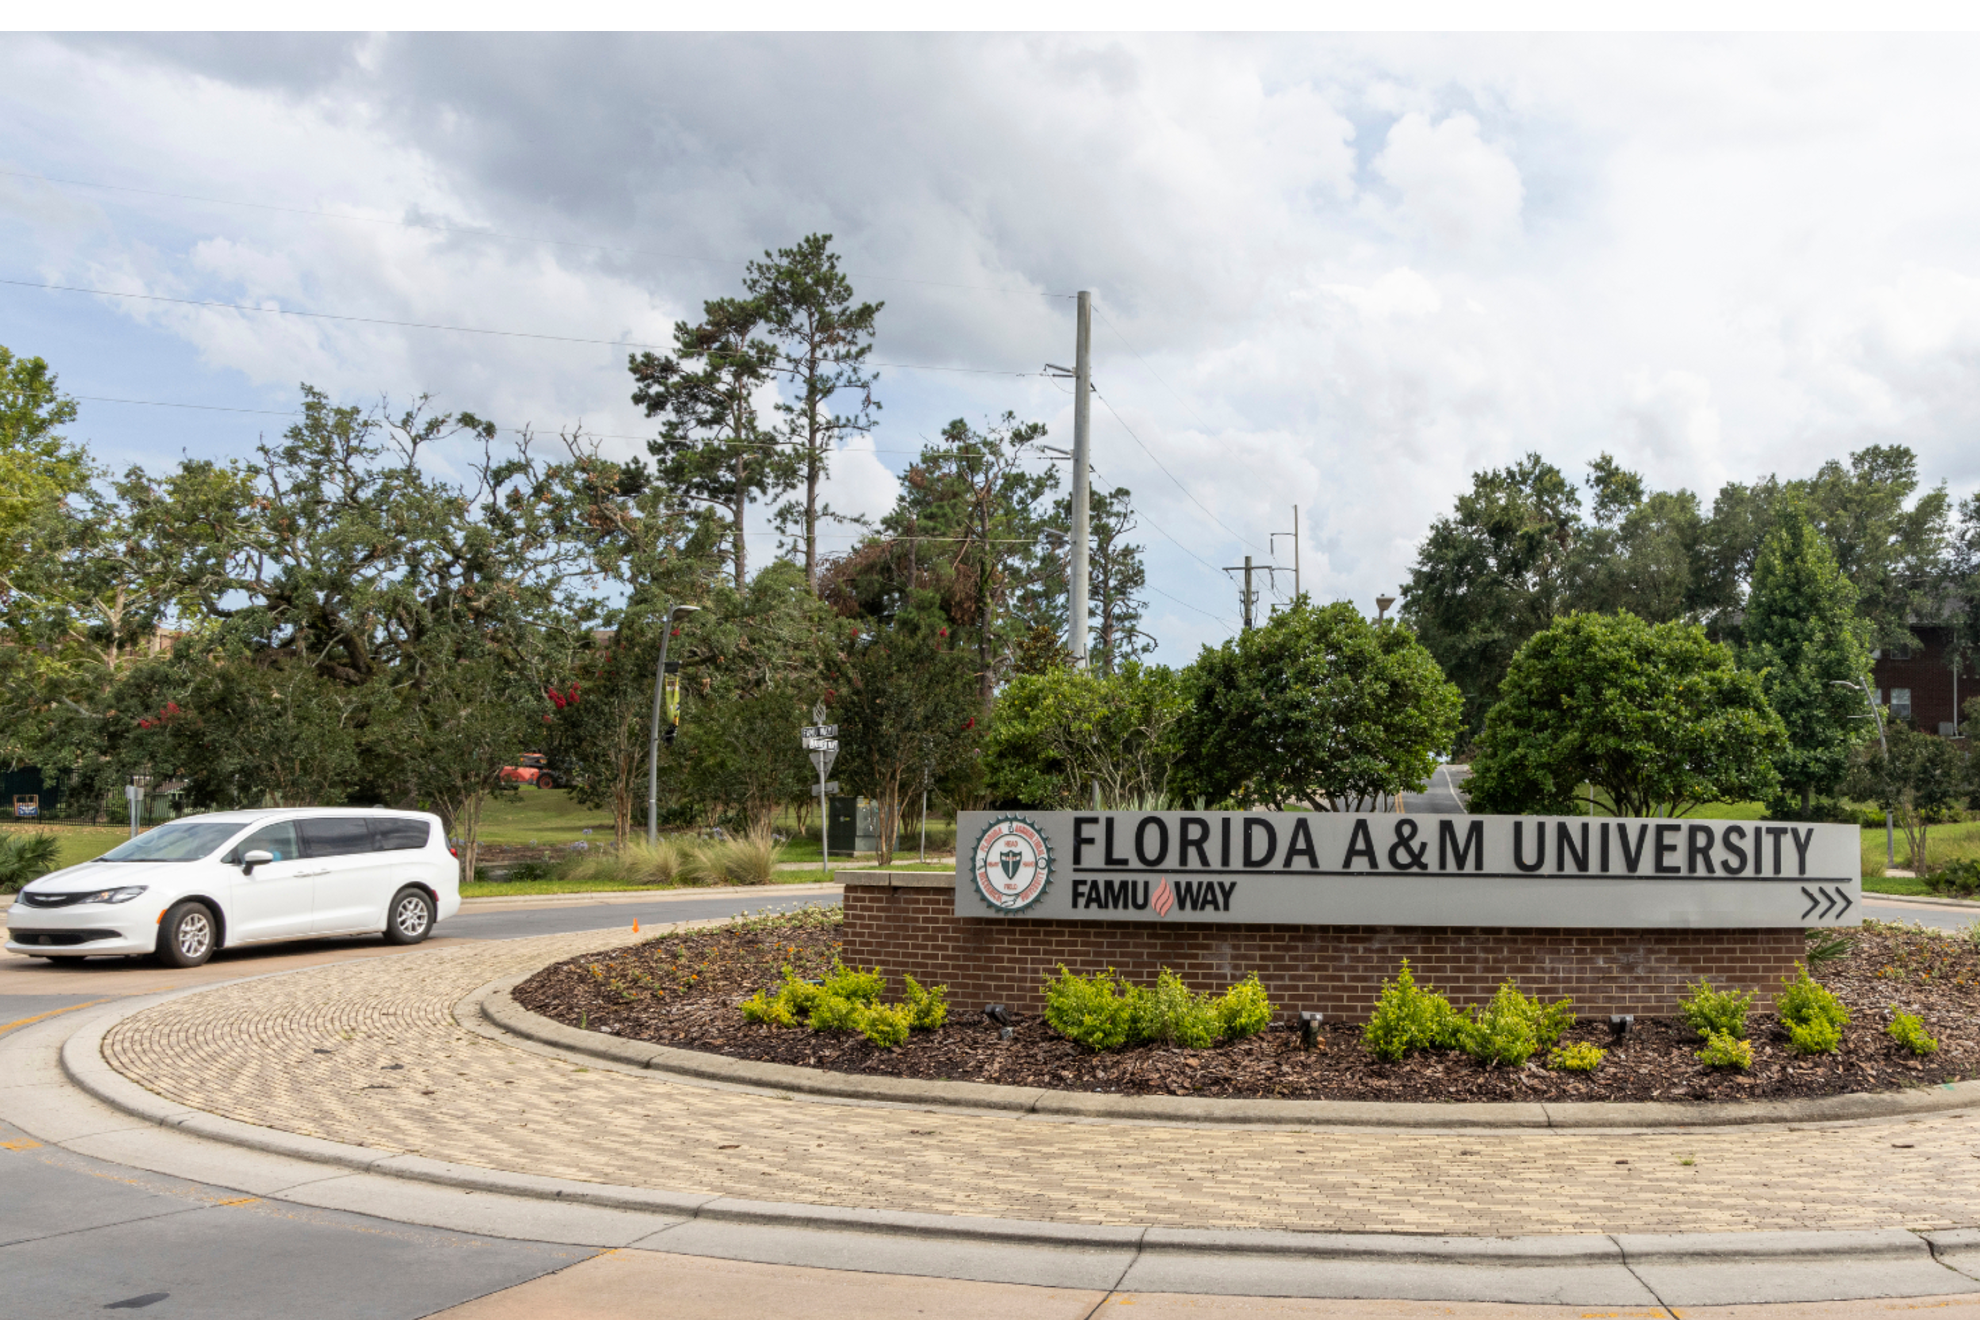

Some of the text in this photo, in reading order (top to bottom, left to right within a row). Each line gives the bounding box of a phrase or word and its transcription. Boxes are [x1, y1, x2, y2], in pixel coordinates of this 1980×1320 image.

[1004, 840, 1019, 848] HEAD
[1072, 815, 1814, 875] FLORIDA A&M UNIVERSITY
[1071, 879, 1238, 912] FAMU WAY
